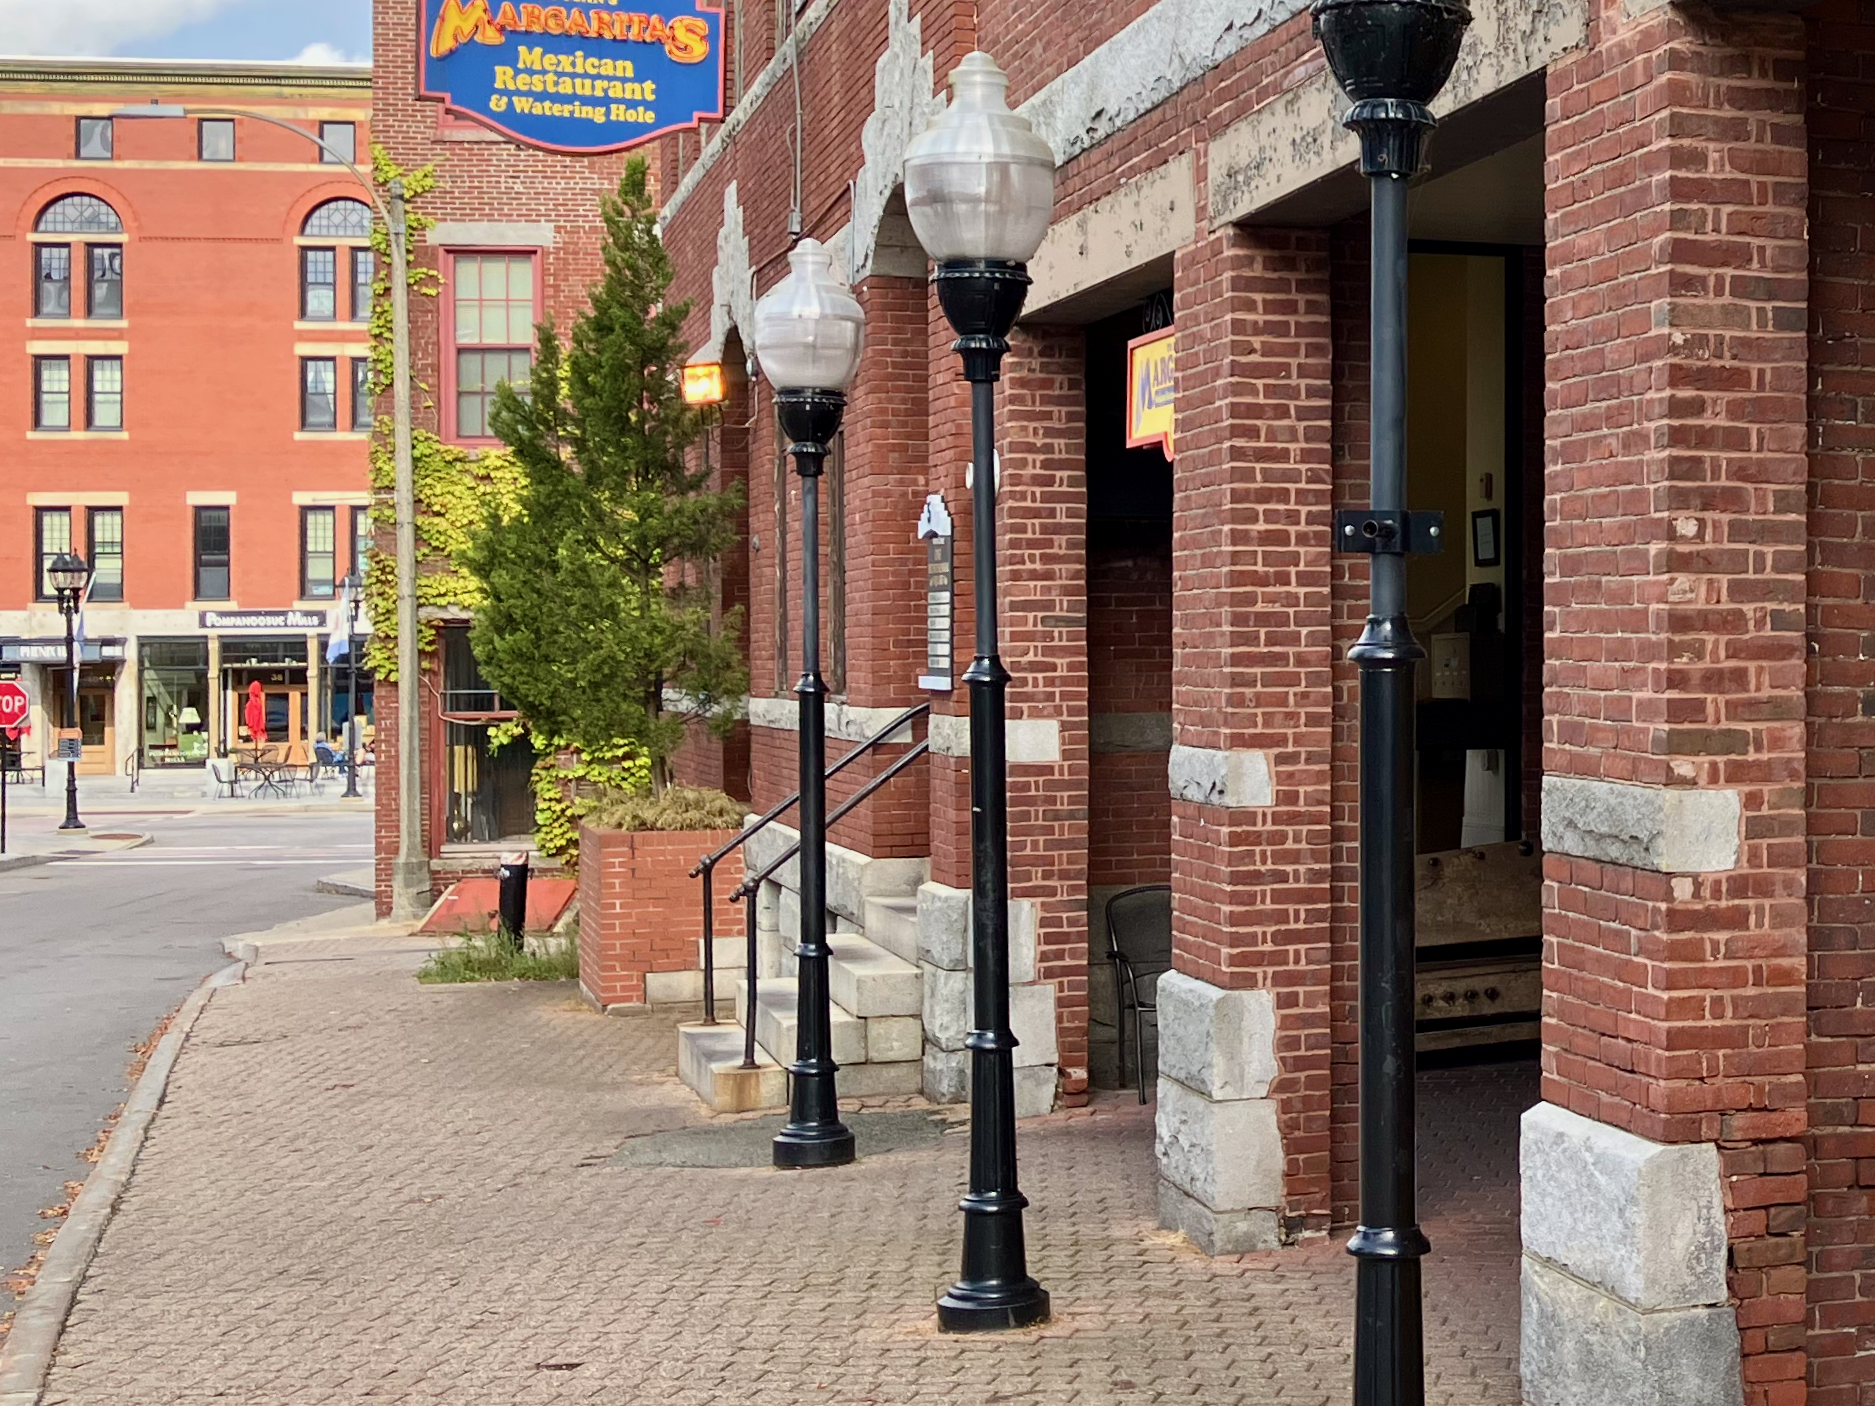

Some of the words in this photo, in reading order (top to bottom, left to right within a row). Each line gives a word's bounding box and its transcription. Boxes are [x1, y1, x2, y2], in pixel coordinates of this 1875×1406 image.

[517, 45, 634, 78] Mexican
[494, 65, 656, 101] Restaurant
[489, 95, 508, 112] &
[512, 95, 606, 123] Watering
[609, 103, 656, 124] Hole
[286, 611, 319, 626] MILLS
